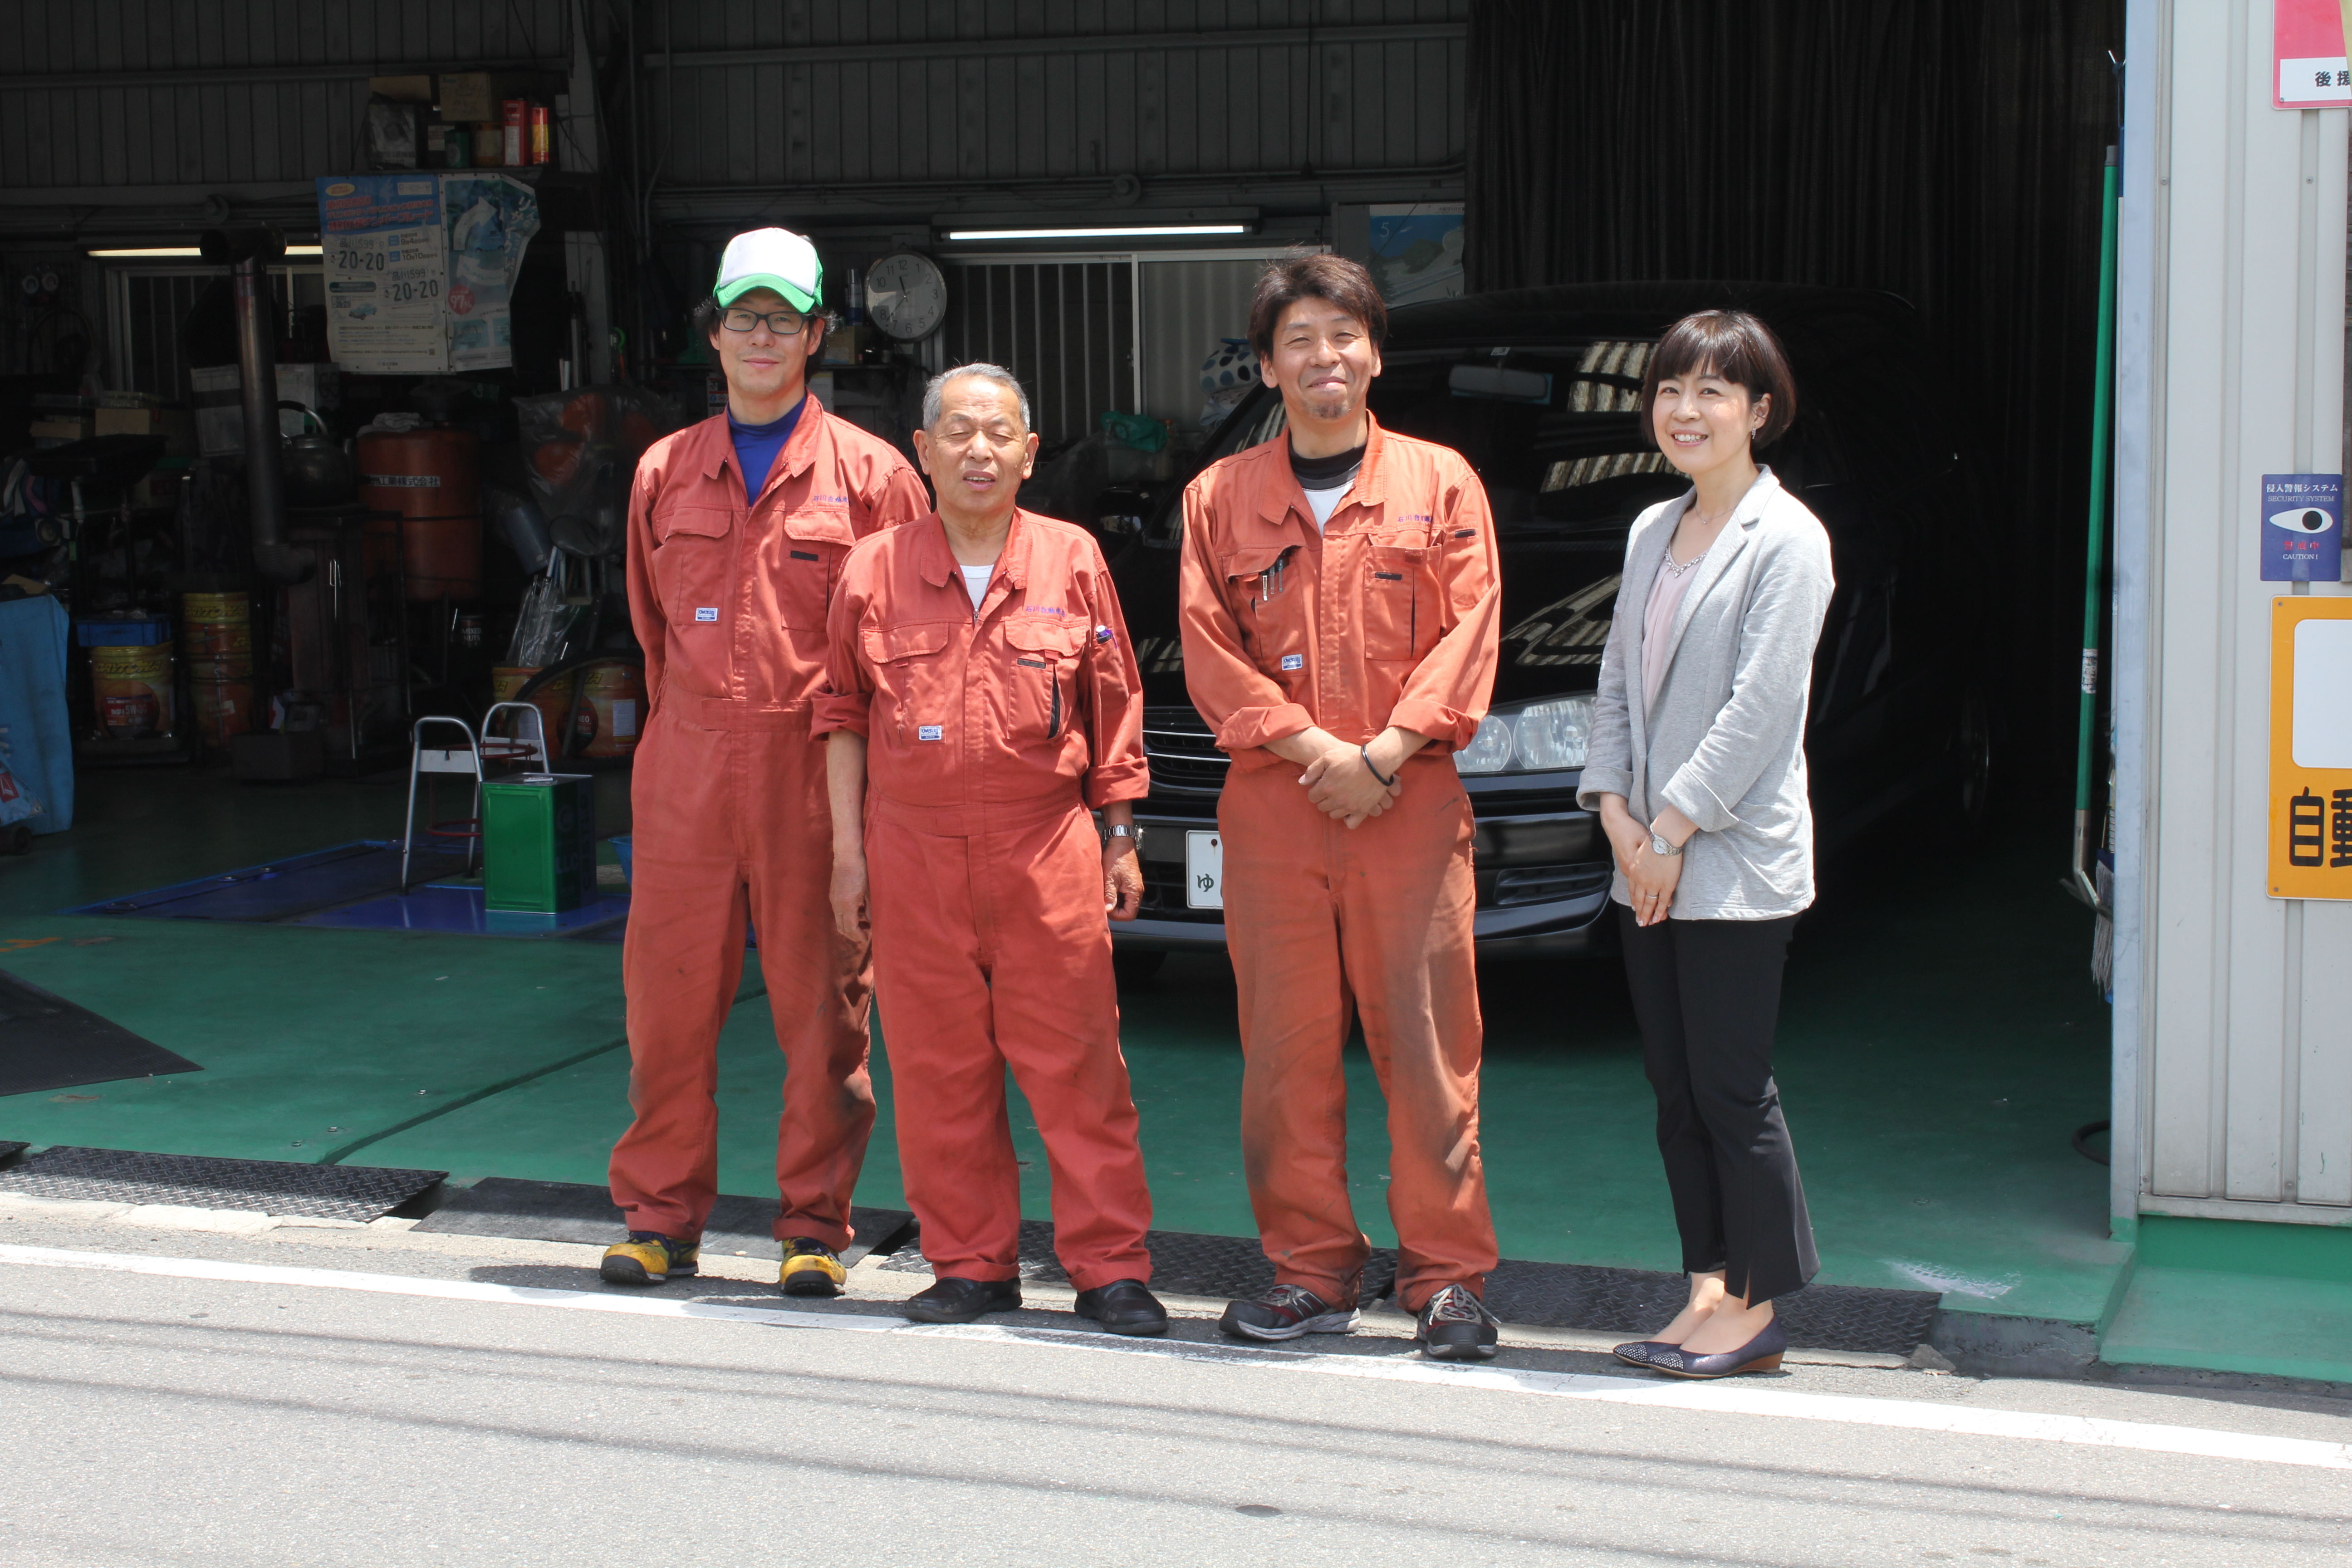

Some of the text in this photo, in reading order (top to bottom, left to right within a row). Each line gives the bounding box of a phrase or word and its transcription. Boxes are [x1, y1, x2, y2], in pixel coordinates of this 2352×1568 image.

[1380, 222, 1389, 237] 5
[339, 250, 384, 271] 20-20
[898, 260, 907, 270] 12
[887, 265, 894, 275] 11
[916, 263, 919, 272] 1
[876, 277, 886, 288] 10
[926, 274, 931, 284] 2
[392, 279, 439, 301] 20-20
[932, 289, 938, 299] 3
[880, 309, 886, 320] 8
[928, 306, 934, 316] 4
[893, 320, 898, 330] 7
[905, 323, 911, 333] 6
[919, 318, 925, 328] 5
[371, 476, 439, 486] 州工業株式会社
[2266, 484, 2338, 493] 侵入警報システム
[184, 604, 246, 618] DAYTONA
[95, 659, 162, 674] DAYTONA
[125, 704, 147, 715] 5W-30
[556, 853, 578, 874] LLC
[1197, 874, 1214, 892] ゆ
